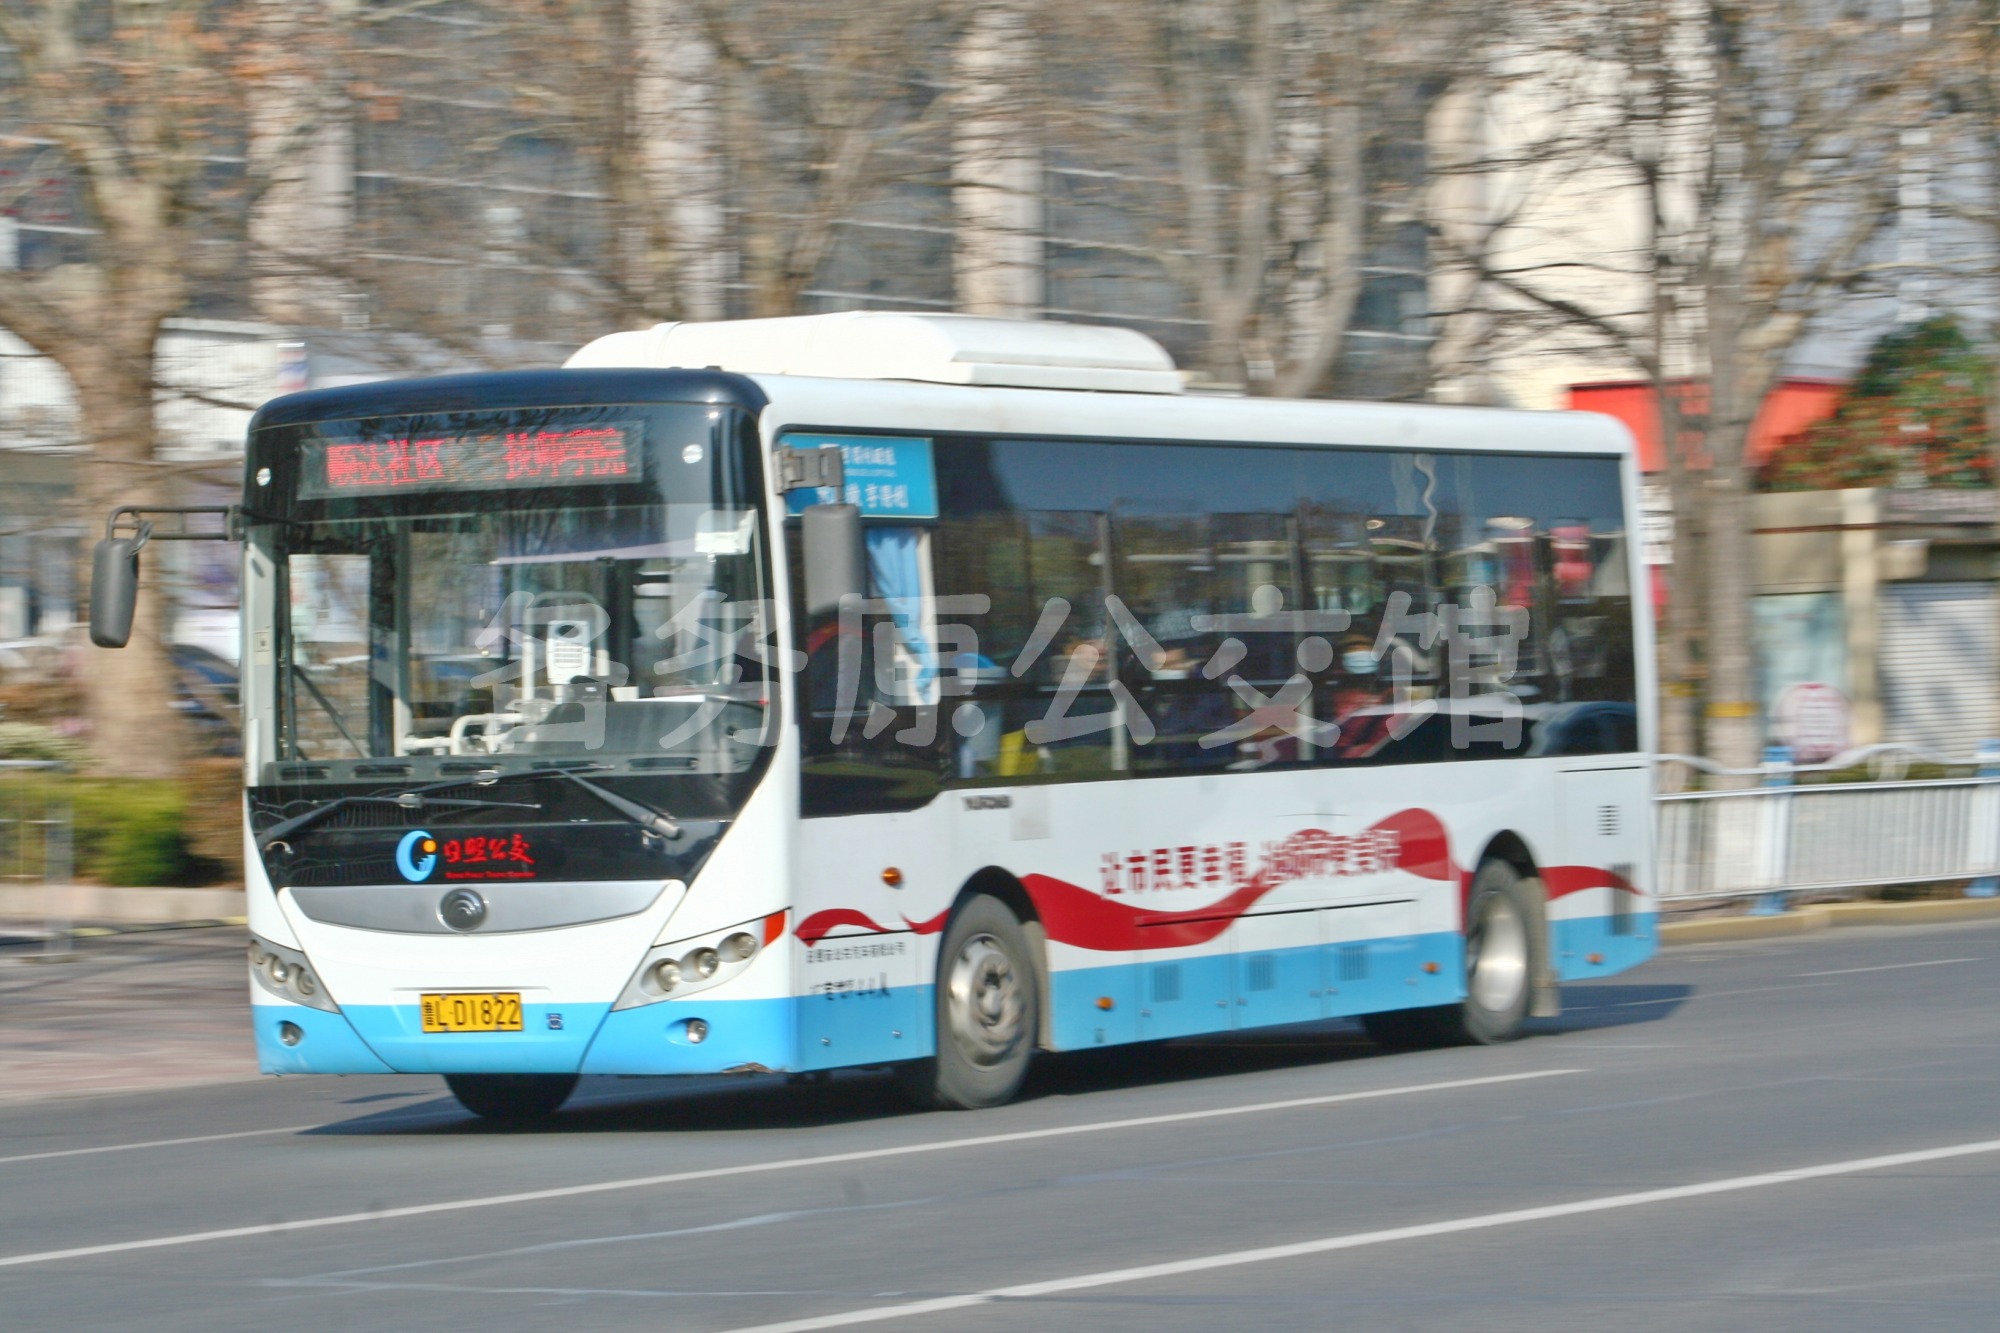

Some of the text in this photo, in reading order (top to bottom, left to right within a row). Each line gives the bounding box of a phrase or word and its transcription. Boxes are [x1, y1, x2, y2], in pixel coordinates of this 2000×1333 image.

[442, 833, 535, 865] 日照公交
[1099, 841, 1249, 895] 让市民更幸福
